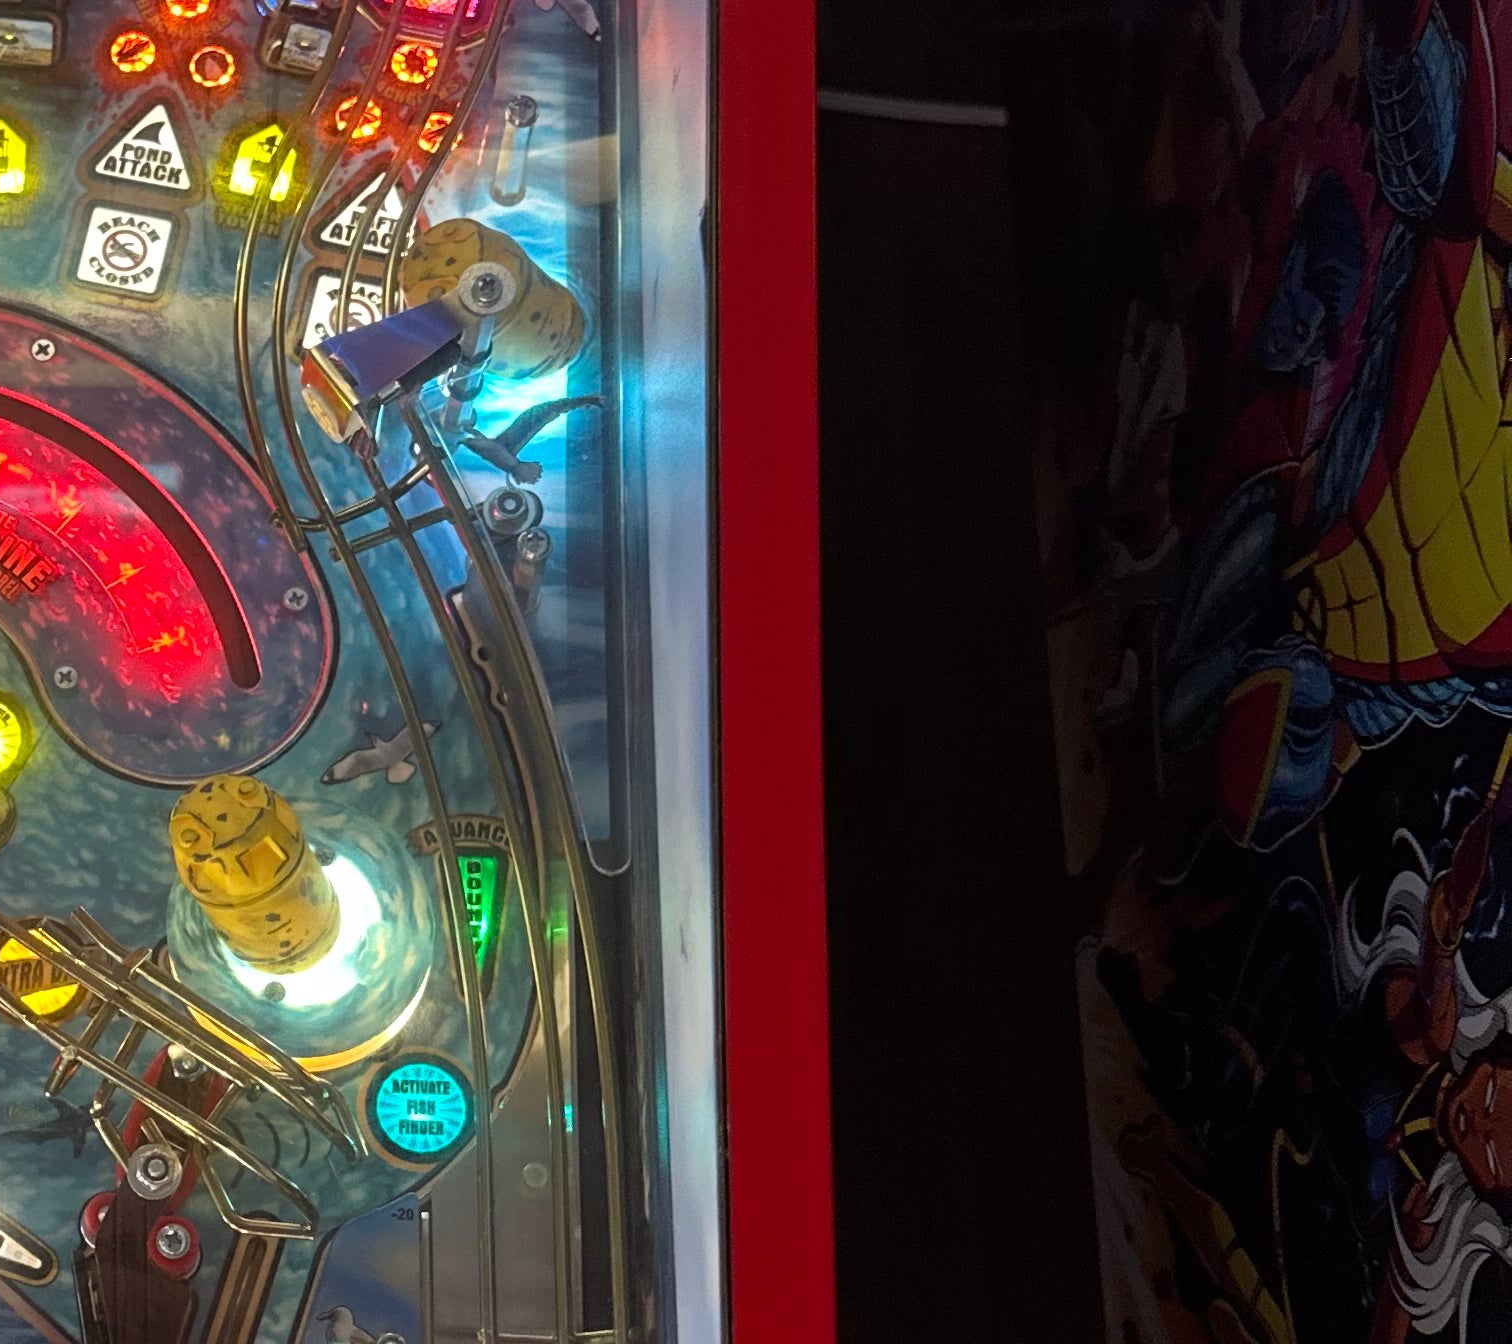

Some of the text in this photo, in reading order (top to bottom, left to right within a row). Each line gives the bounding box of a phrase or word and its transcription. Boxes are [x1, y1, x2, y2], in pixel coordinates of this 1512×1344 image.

[121, 140, 173, 166] POND
[103, 156, 185, 185] ATTACK
[97, 211, 161, 246] BEACH
[88, 258, 155, 290] CLOSED
[392, 1079, 452, 1096] ACTIVATE
[406, 1099, 437, 1116] FISH
[398, 1119, 445, 1136] FINDER
[391, 1208, 414, 1221] -20
